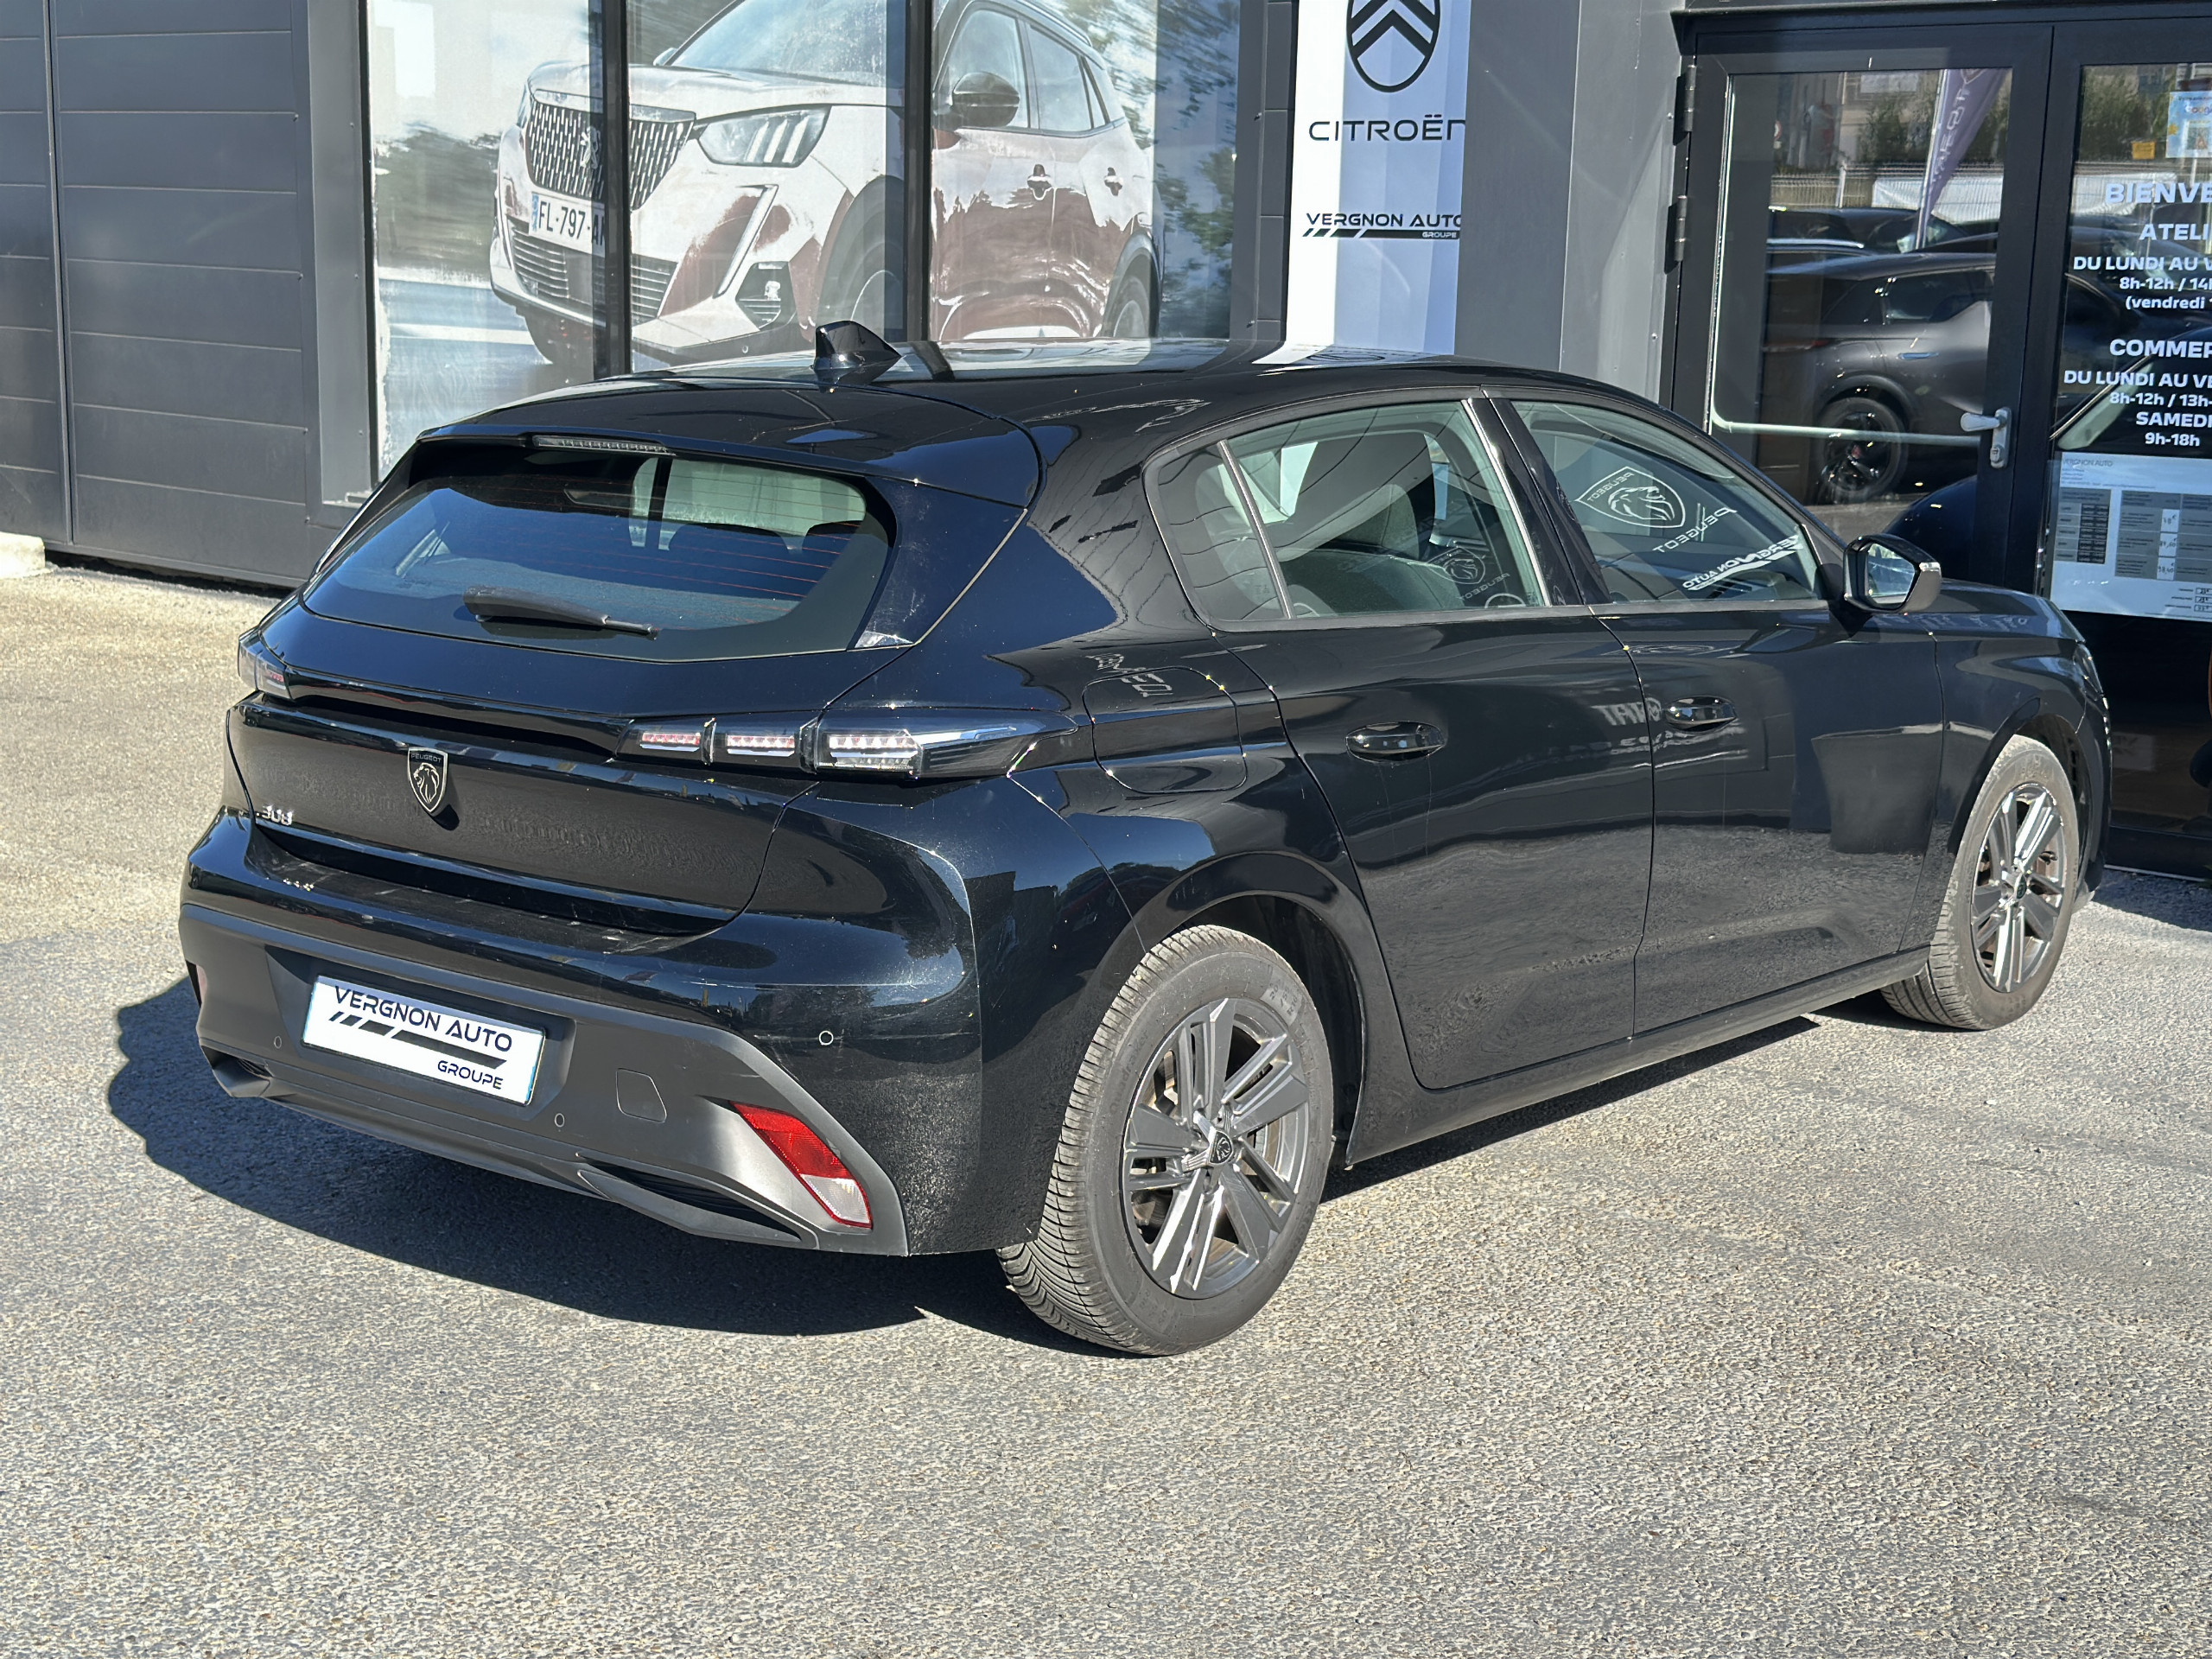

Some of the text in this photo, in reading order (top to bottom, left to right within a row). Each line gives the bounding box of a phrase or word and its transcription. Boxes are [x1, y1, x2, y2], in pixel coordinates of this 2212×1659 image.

[1306, 213, 1403, 227] VERGNON
[2074, 257, 2101, 270] DU
[2106, 257, 2164, 270] LUNDI
[2168, 257, 2198, 270] AU
[2120, 276, 2174, 289] 8h-12h
[2125, 296, 2205, 309] (vendredi
[2063, 370, 2092, 384] DU
[2095, 371, 2155, 386] LUNDI
[2158, 372, 2189, 388] AU
[2109, 392, 2164, 406] 8h-12h
[2145, 432, 2201, 447] 9h-18h
[410, 753, 442, 762] PEUGEOT
[261, 804, 294, 826] 308
[334, 985, 512, 1052] VERGNON AUTO
[437, 1059, 504, 1090] GROUPE
